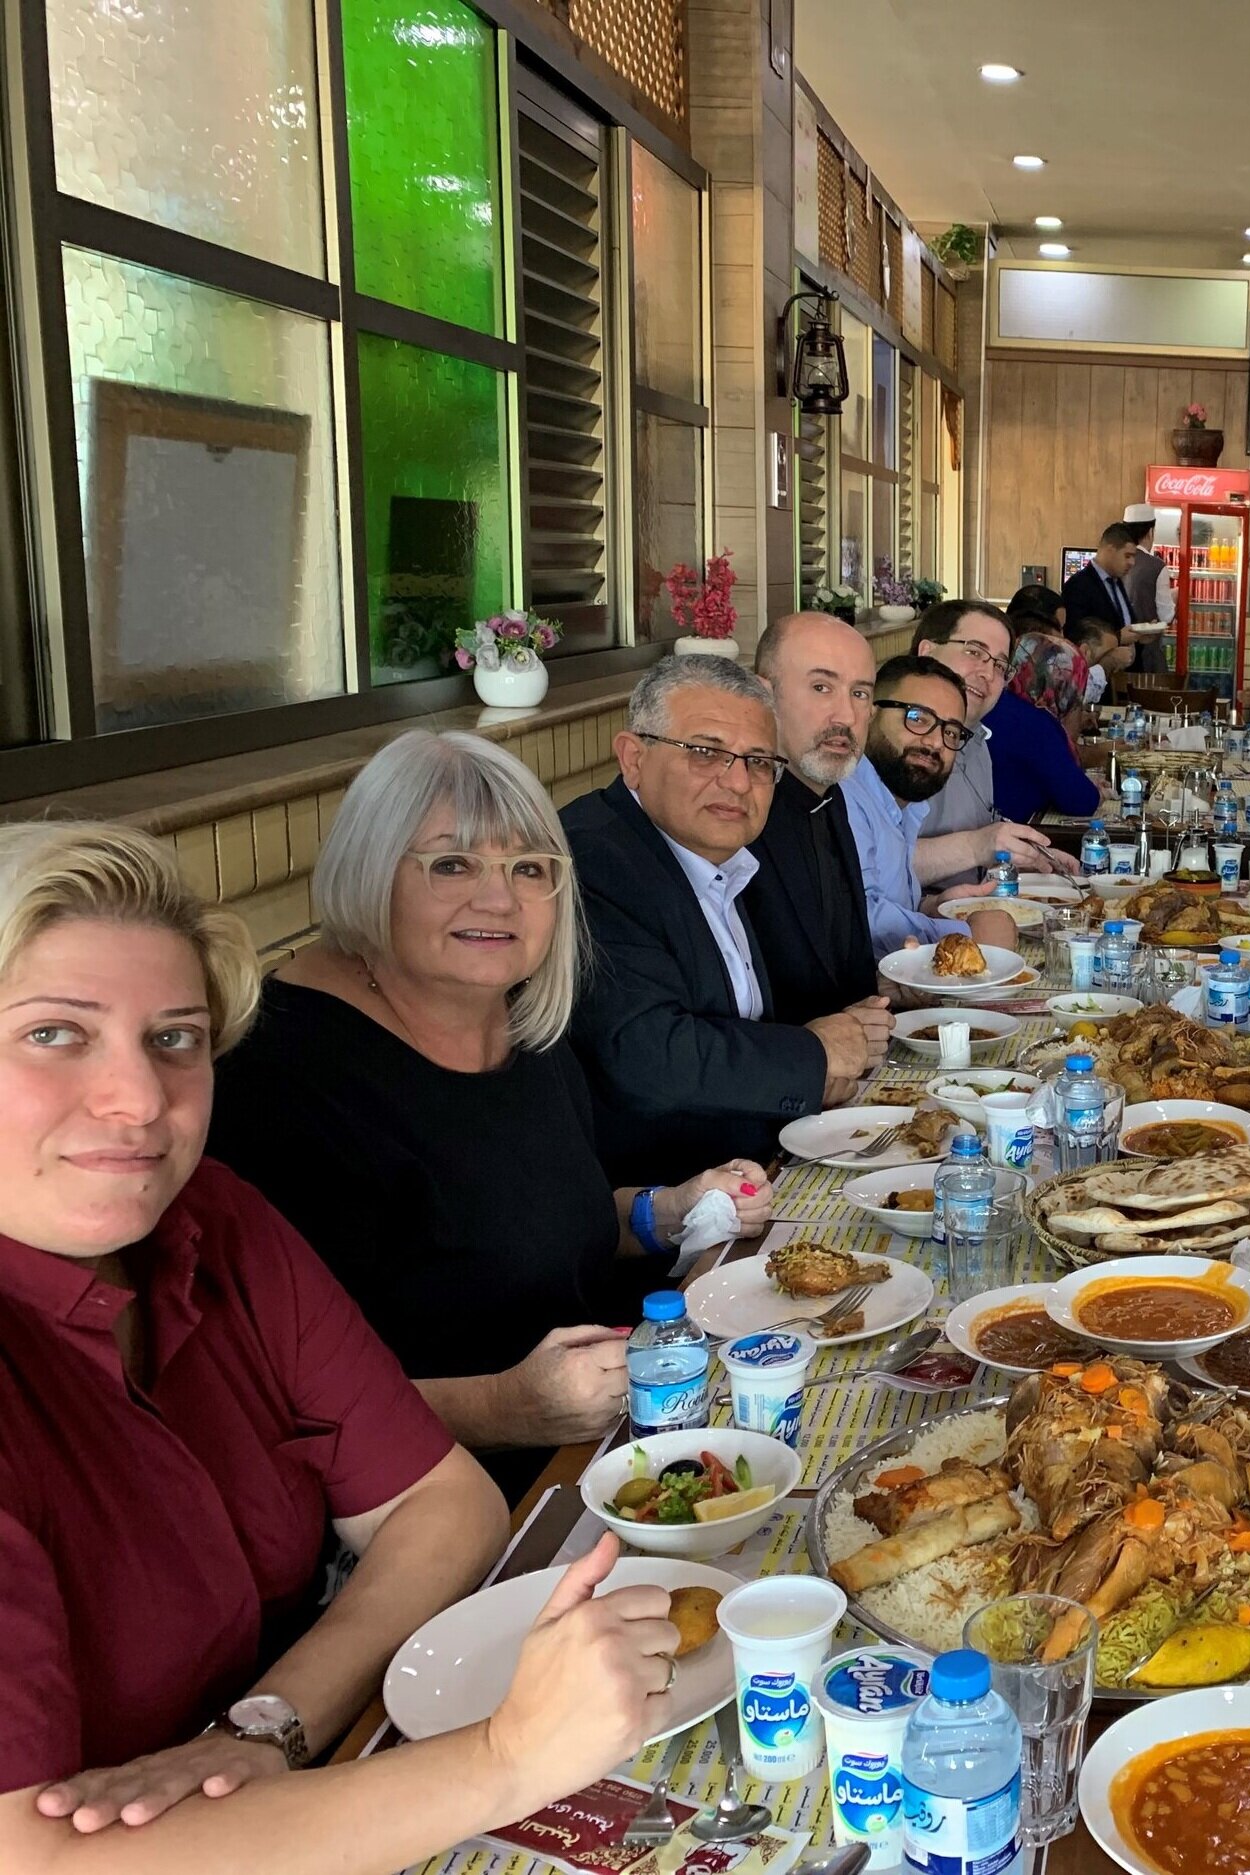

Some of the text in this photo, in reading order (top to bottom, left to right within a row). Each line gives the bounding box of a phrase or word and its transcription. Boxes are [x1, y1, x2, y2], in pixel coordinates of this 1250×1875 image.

[729, 1335, 796, 1358] Ayran
[848, 1653, 894, 1714] Ayran
[743, 1698, 811, 1722] ماستاو
[763, 1755, 777, 1764] 200
[836, 1780, 905, 1806] ماستاو
